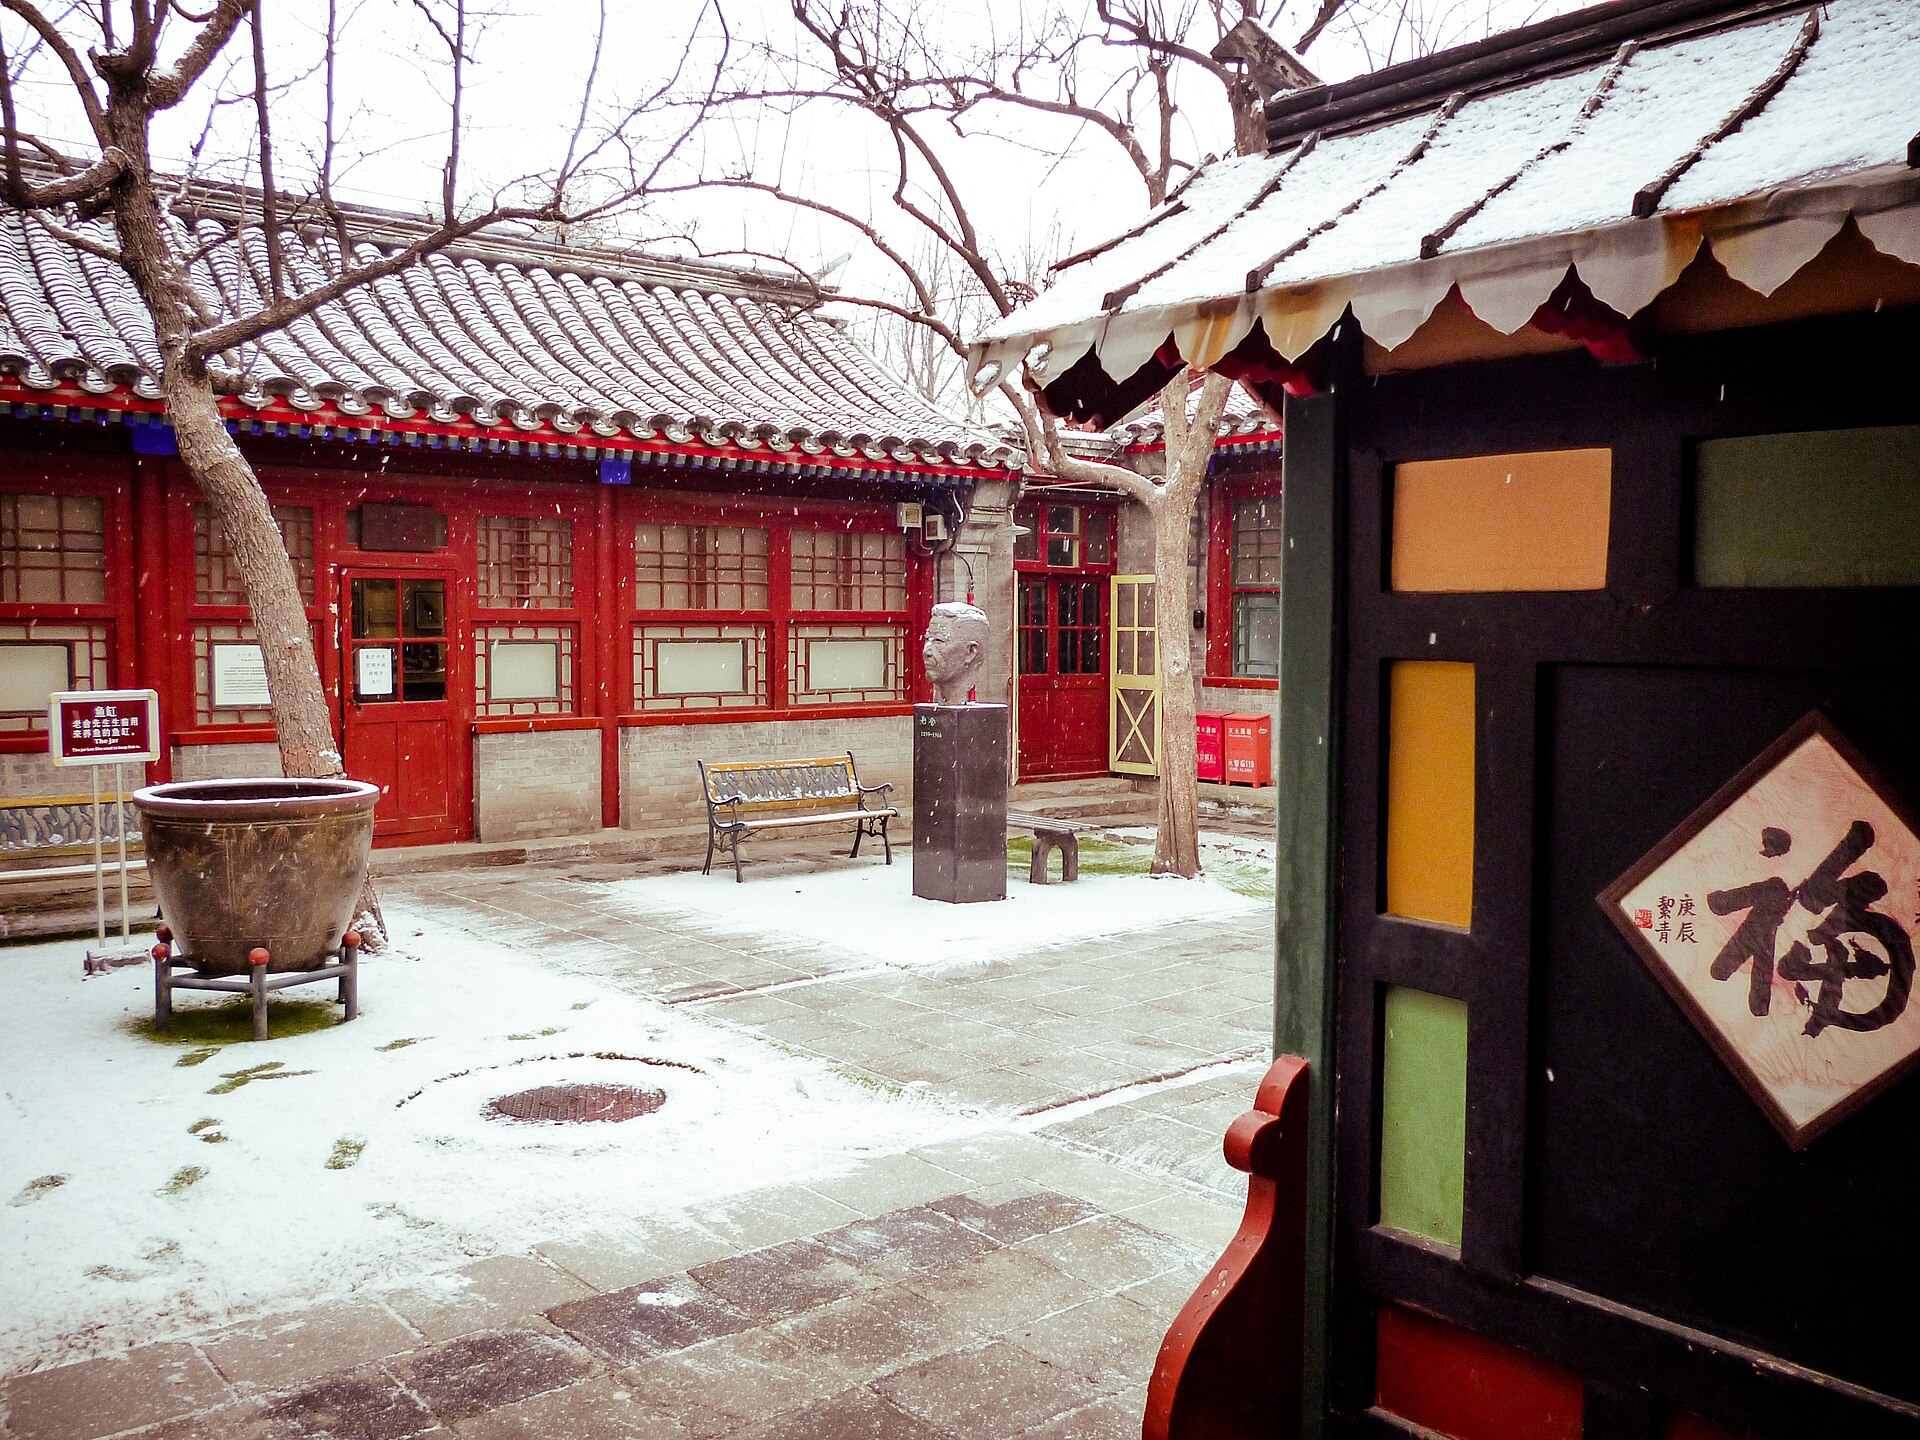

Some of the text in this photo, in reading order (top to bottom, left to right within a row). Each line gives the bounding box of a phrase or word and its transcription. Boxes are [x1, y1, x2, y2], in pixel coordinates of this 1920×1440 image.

[95, 706, 117, 717] 鱼缸
[73, 717, 139, 728] 老舍先生生前用
[920, 715, 936, 727] 老舍
[1676, 893, 1699, 944] 庚辰
[1707, 820, 1916, 1038] 福
